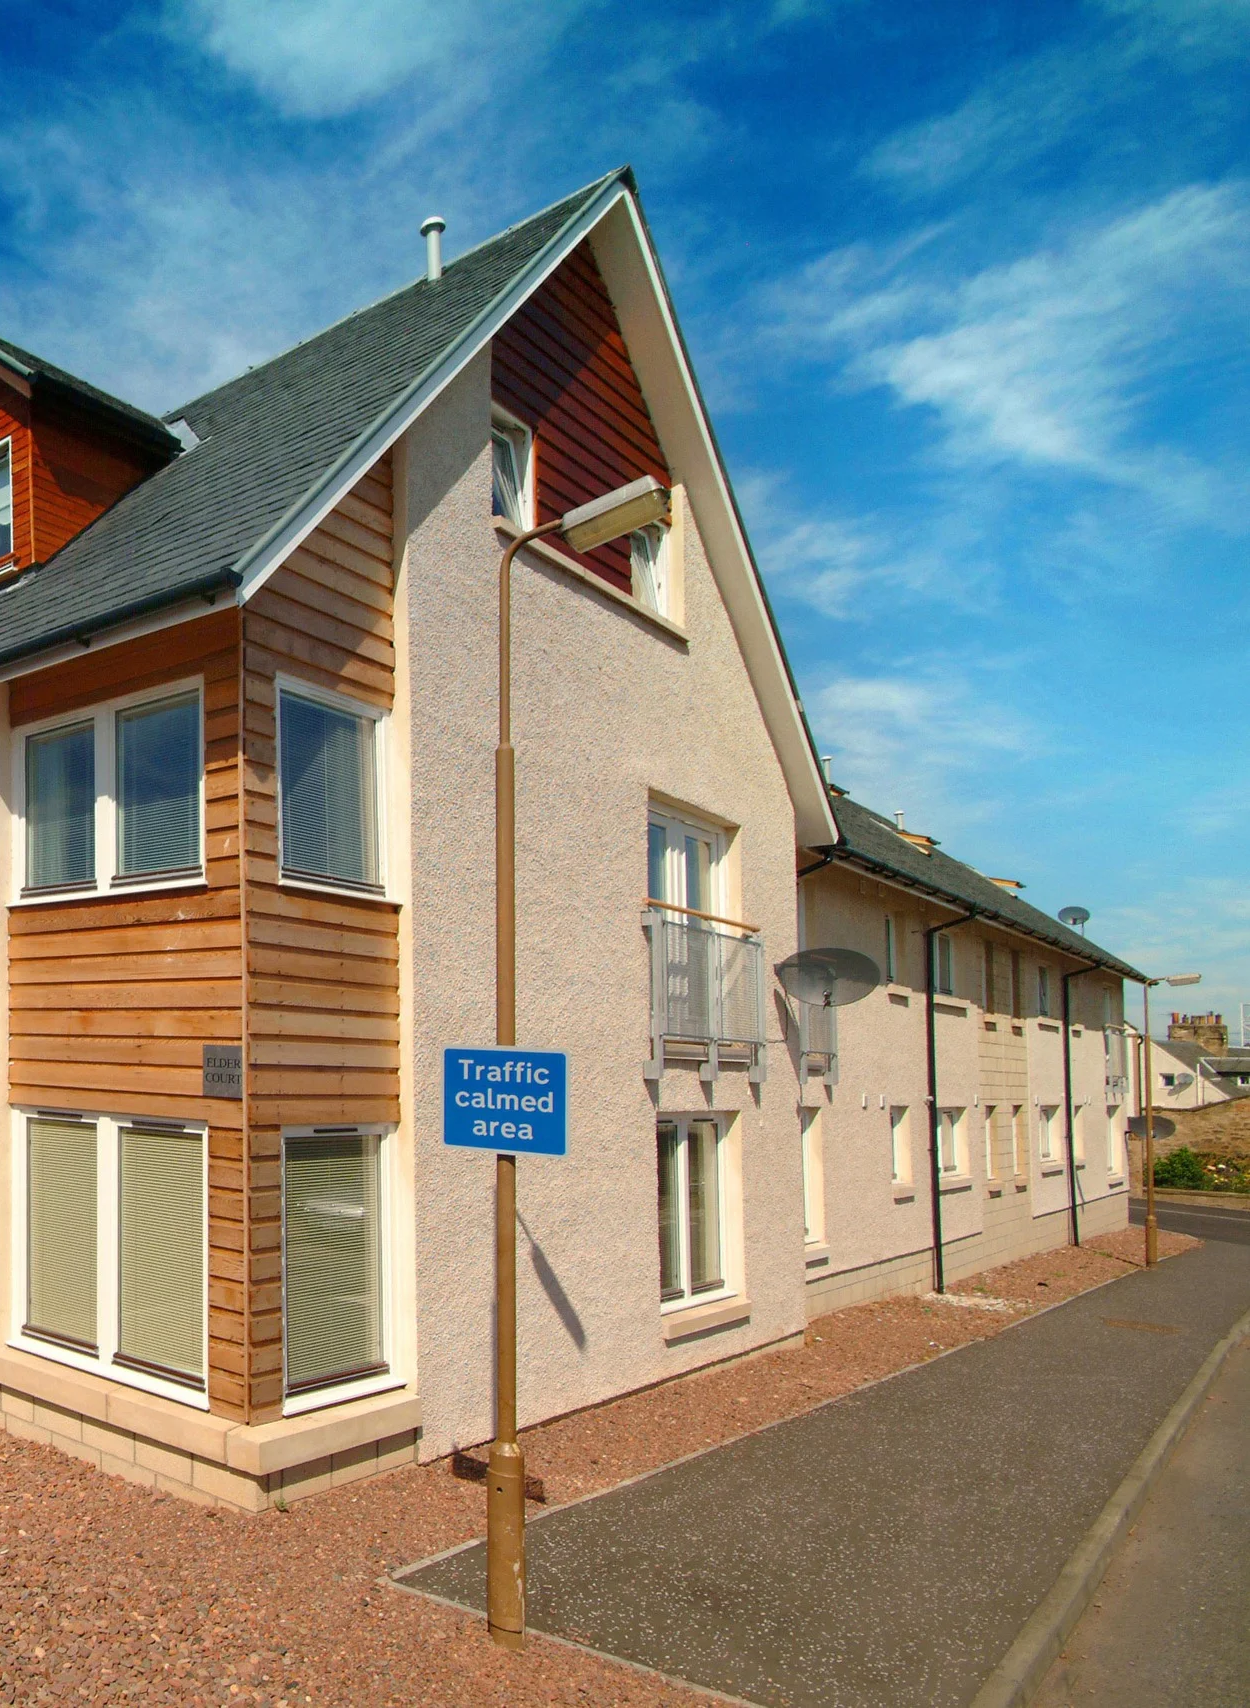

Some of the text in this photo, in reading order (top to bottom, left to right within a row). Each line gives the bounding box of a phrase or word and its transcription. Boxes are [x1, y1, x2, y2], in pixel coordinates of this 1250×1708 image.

[206, 1057, 241, 1069] ELDER
[458, 1059, 550, 1085] Traffic
[205, 1072, 242, 1084] COURT
[455, 1088, 554, 1113] calmed
[472, 1119, 534, 1140] area
